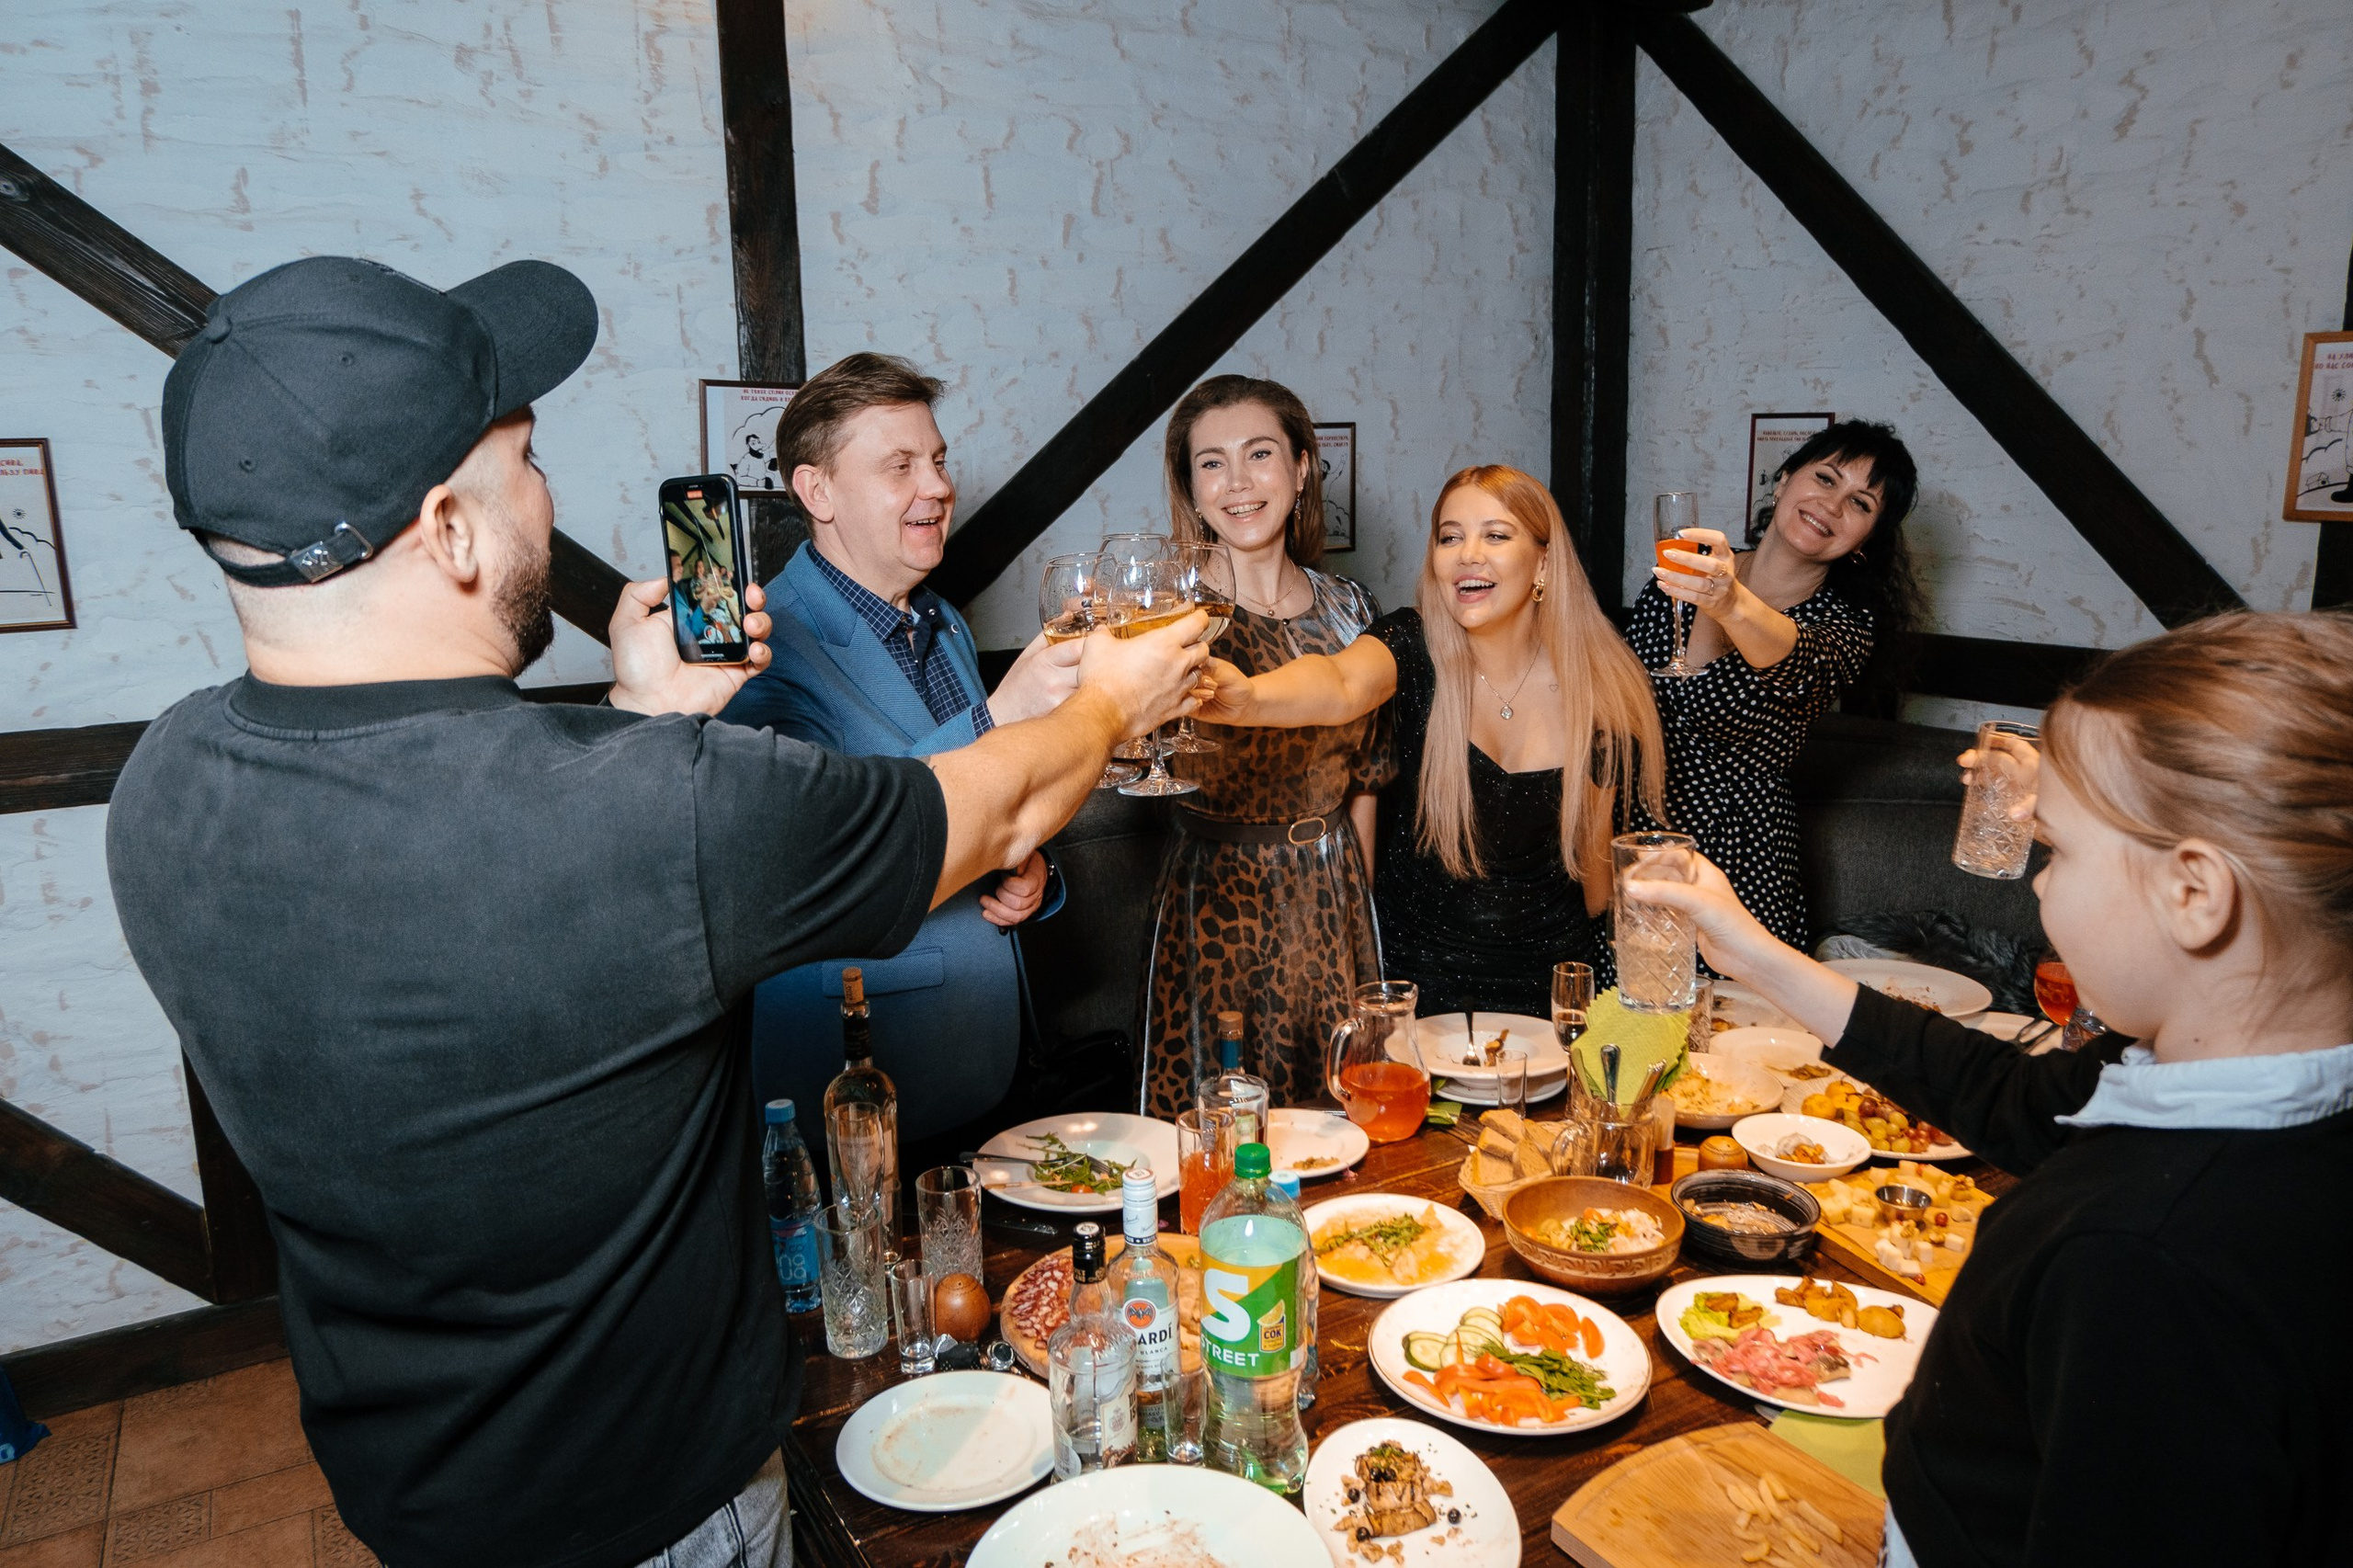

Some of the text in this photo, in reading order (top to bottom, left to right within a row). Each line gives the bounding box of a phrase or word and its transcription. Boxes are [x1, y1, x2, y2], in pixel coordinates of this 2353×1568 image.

[1137, 1321, 1173, 1346] ARDÍ
[1264, 1328, 1281, 1339] СОК
[1140, 1346, 1168, 1356] BLANCA
[1200, 1333, 1260, 1368] STREET
